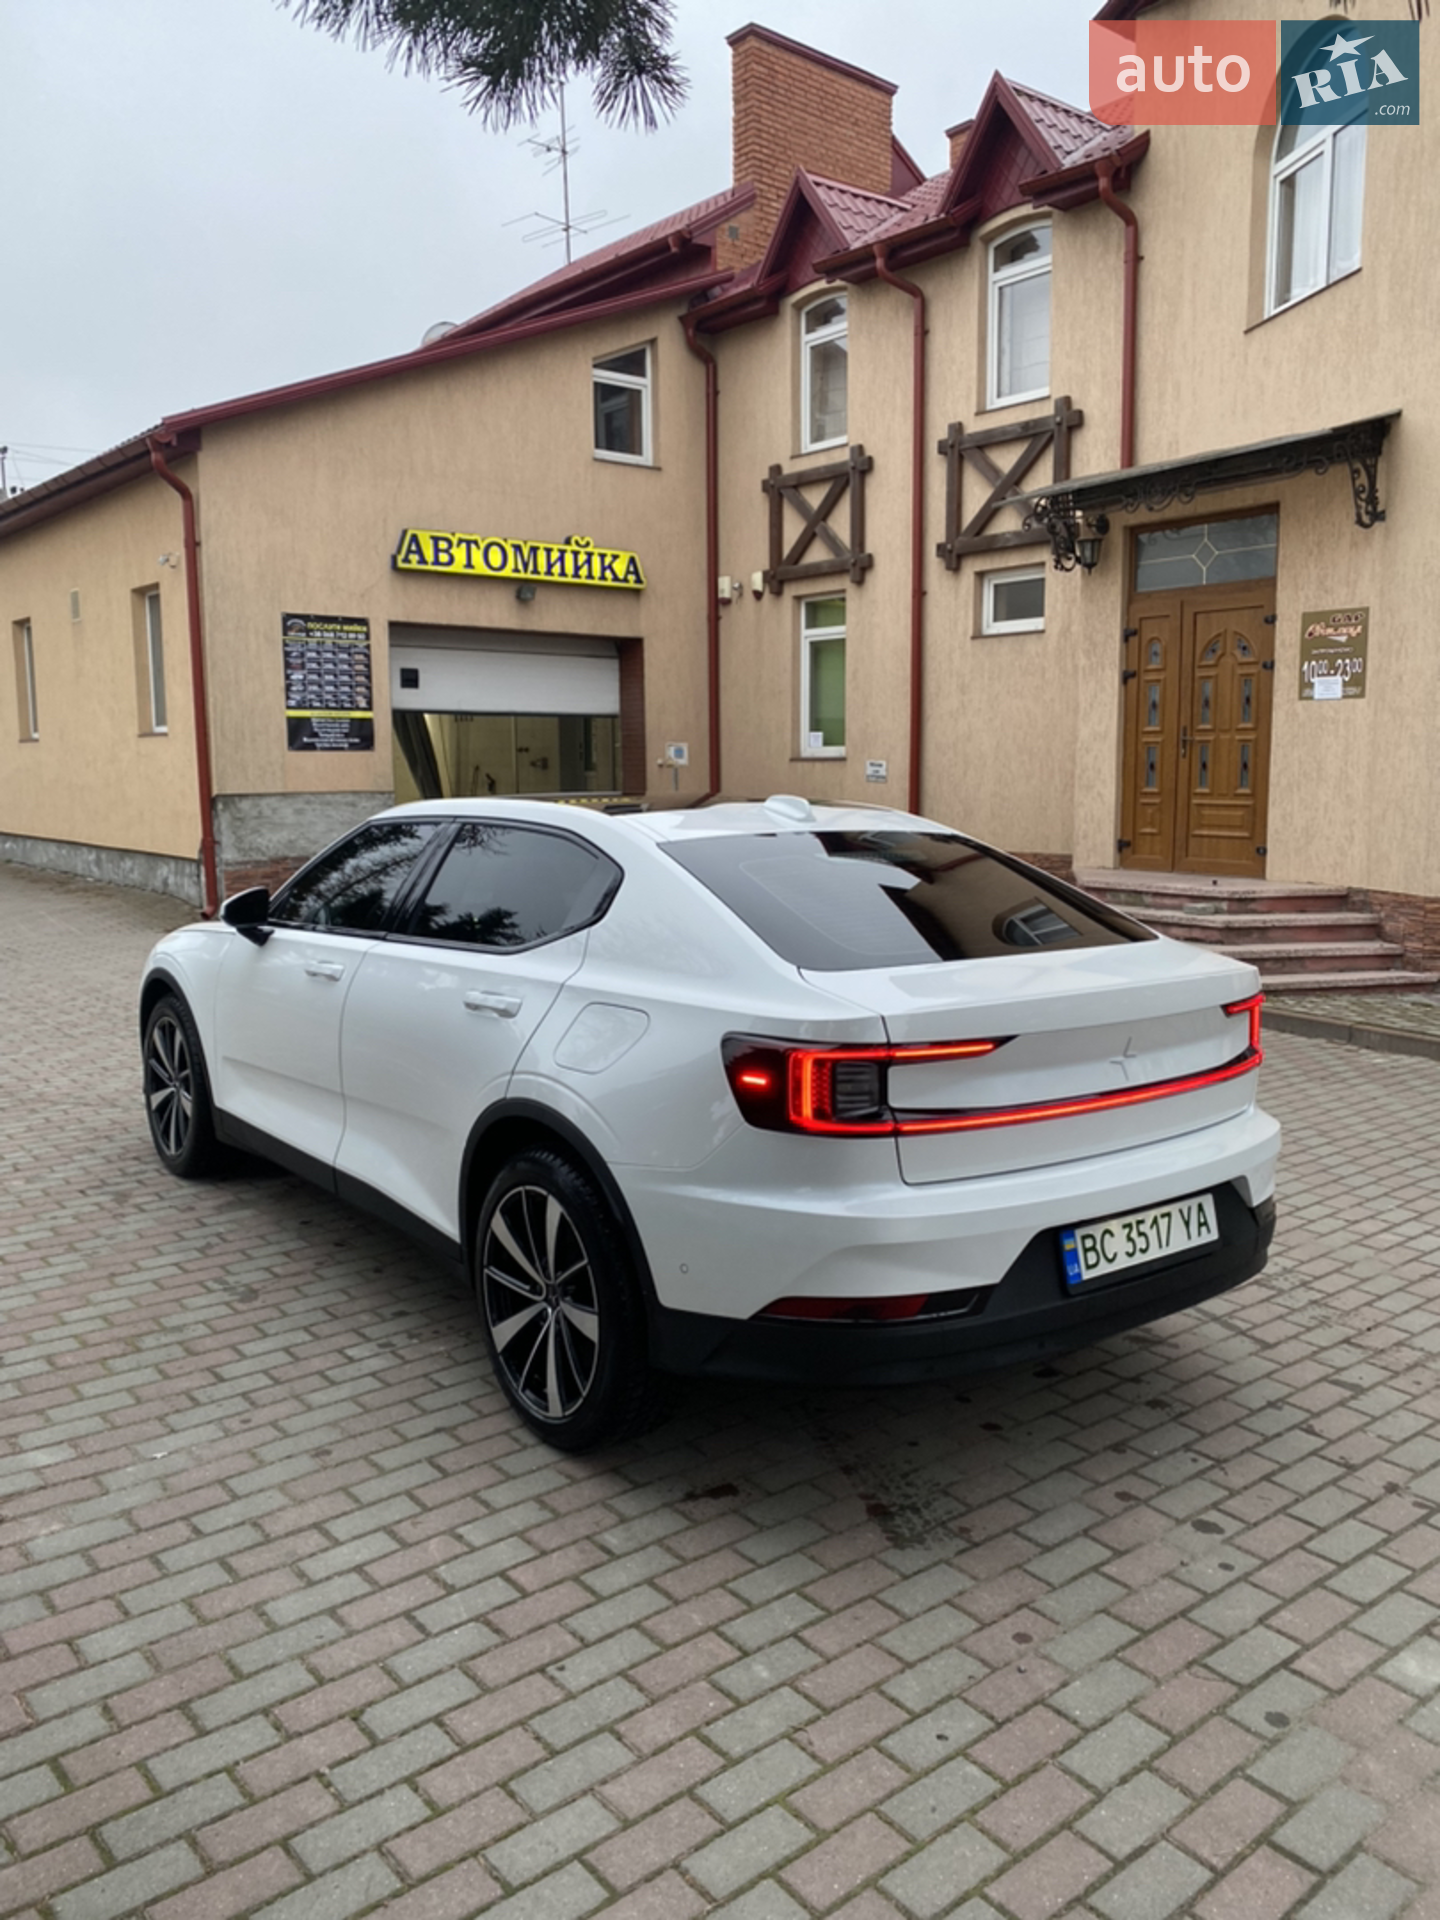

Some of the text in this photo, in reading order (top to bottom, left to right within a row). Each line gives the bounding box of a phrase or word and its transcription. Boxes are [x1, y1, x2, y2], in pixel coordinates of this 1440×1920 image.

[400, 533, 644, 584] АВТОМИЙКА
[1080, 1201, 1212, 1270] BC 3517 YA
